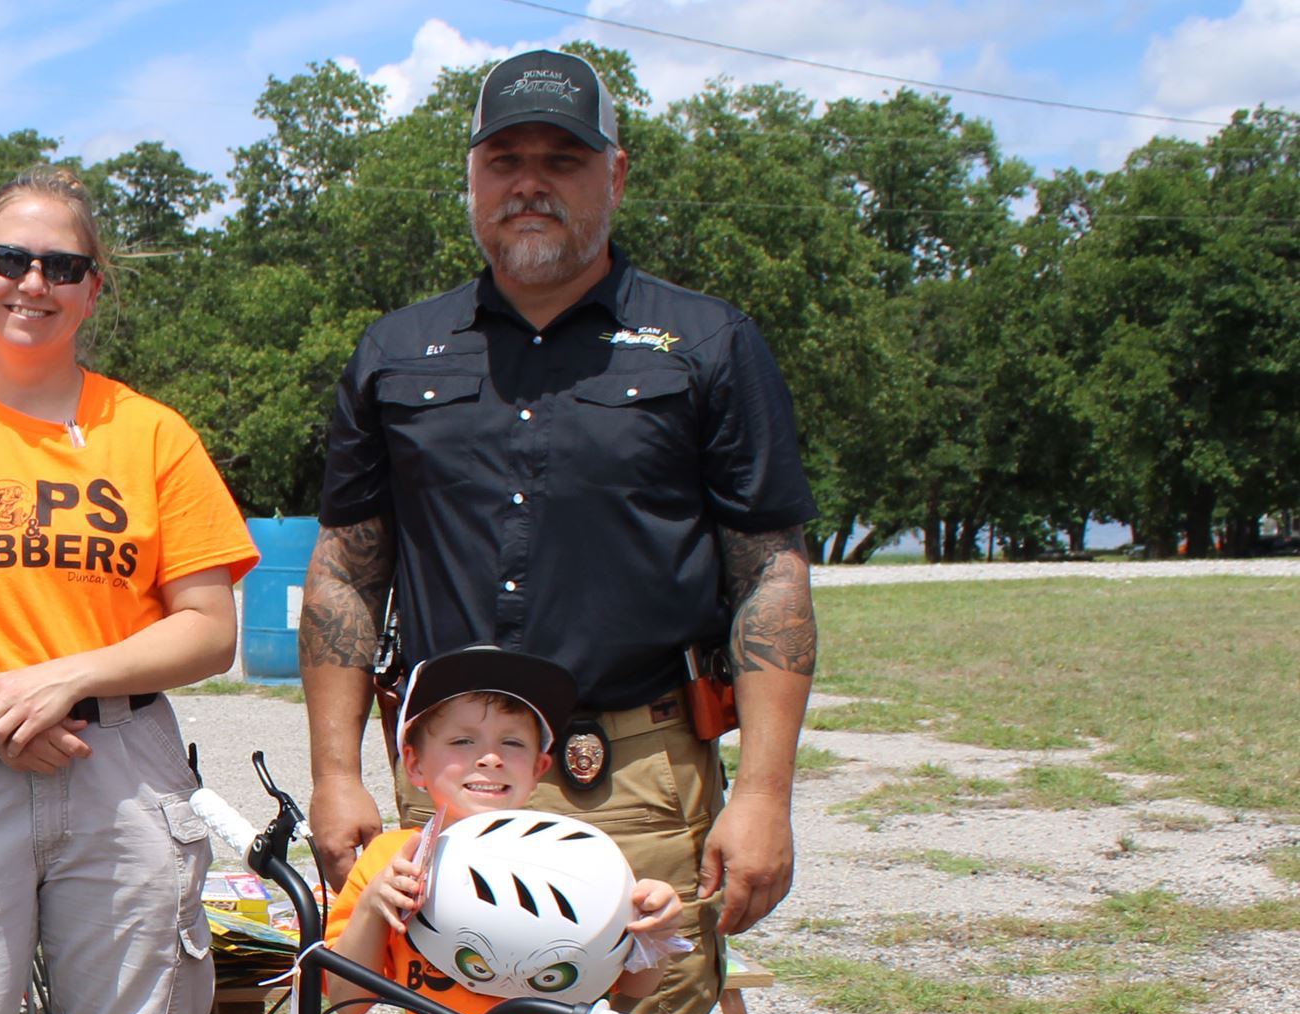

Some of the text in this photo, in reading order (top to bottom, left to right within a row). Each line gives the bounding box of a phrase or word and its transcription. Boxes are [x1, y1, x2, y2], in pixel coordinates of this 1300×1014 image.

[523, 70, 562, 80] DUNCAN
[509, 79, 565, 96] POLICE
[25, 518, 41, 538] &
[112, 577, 129, 590] OK
